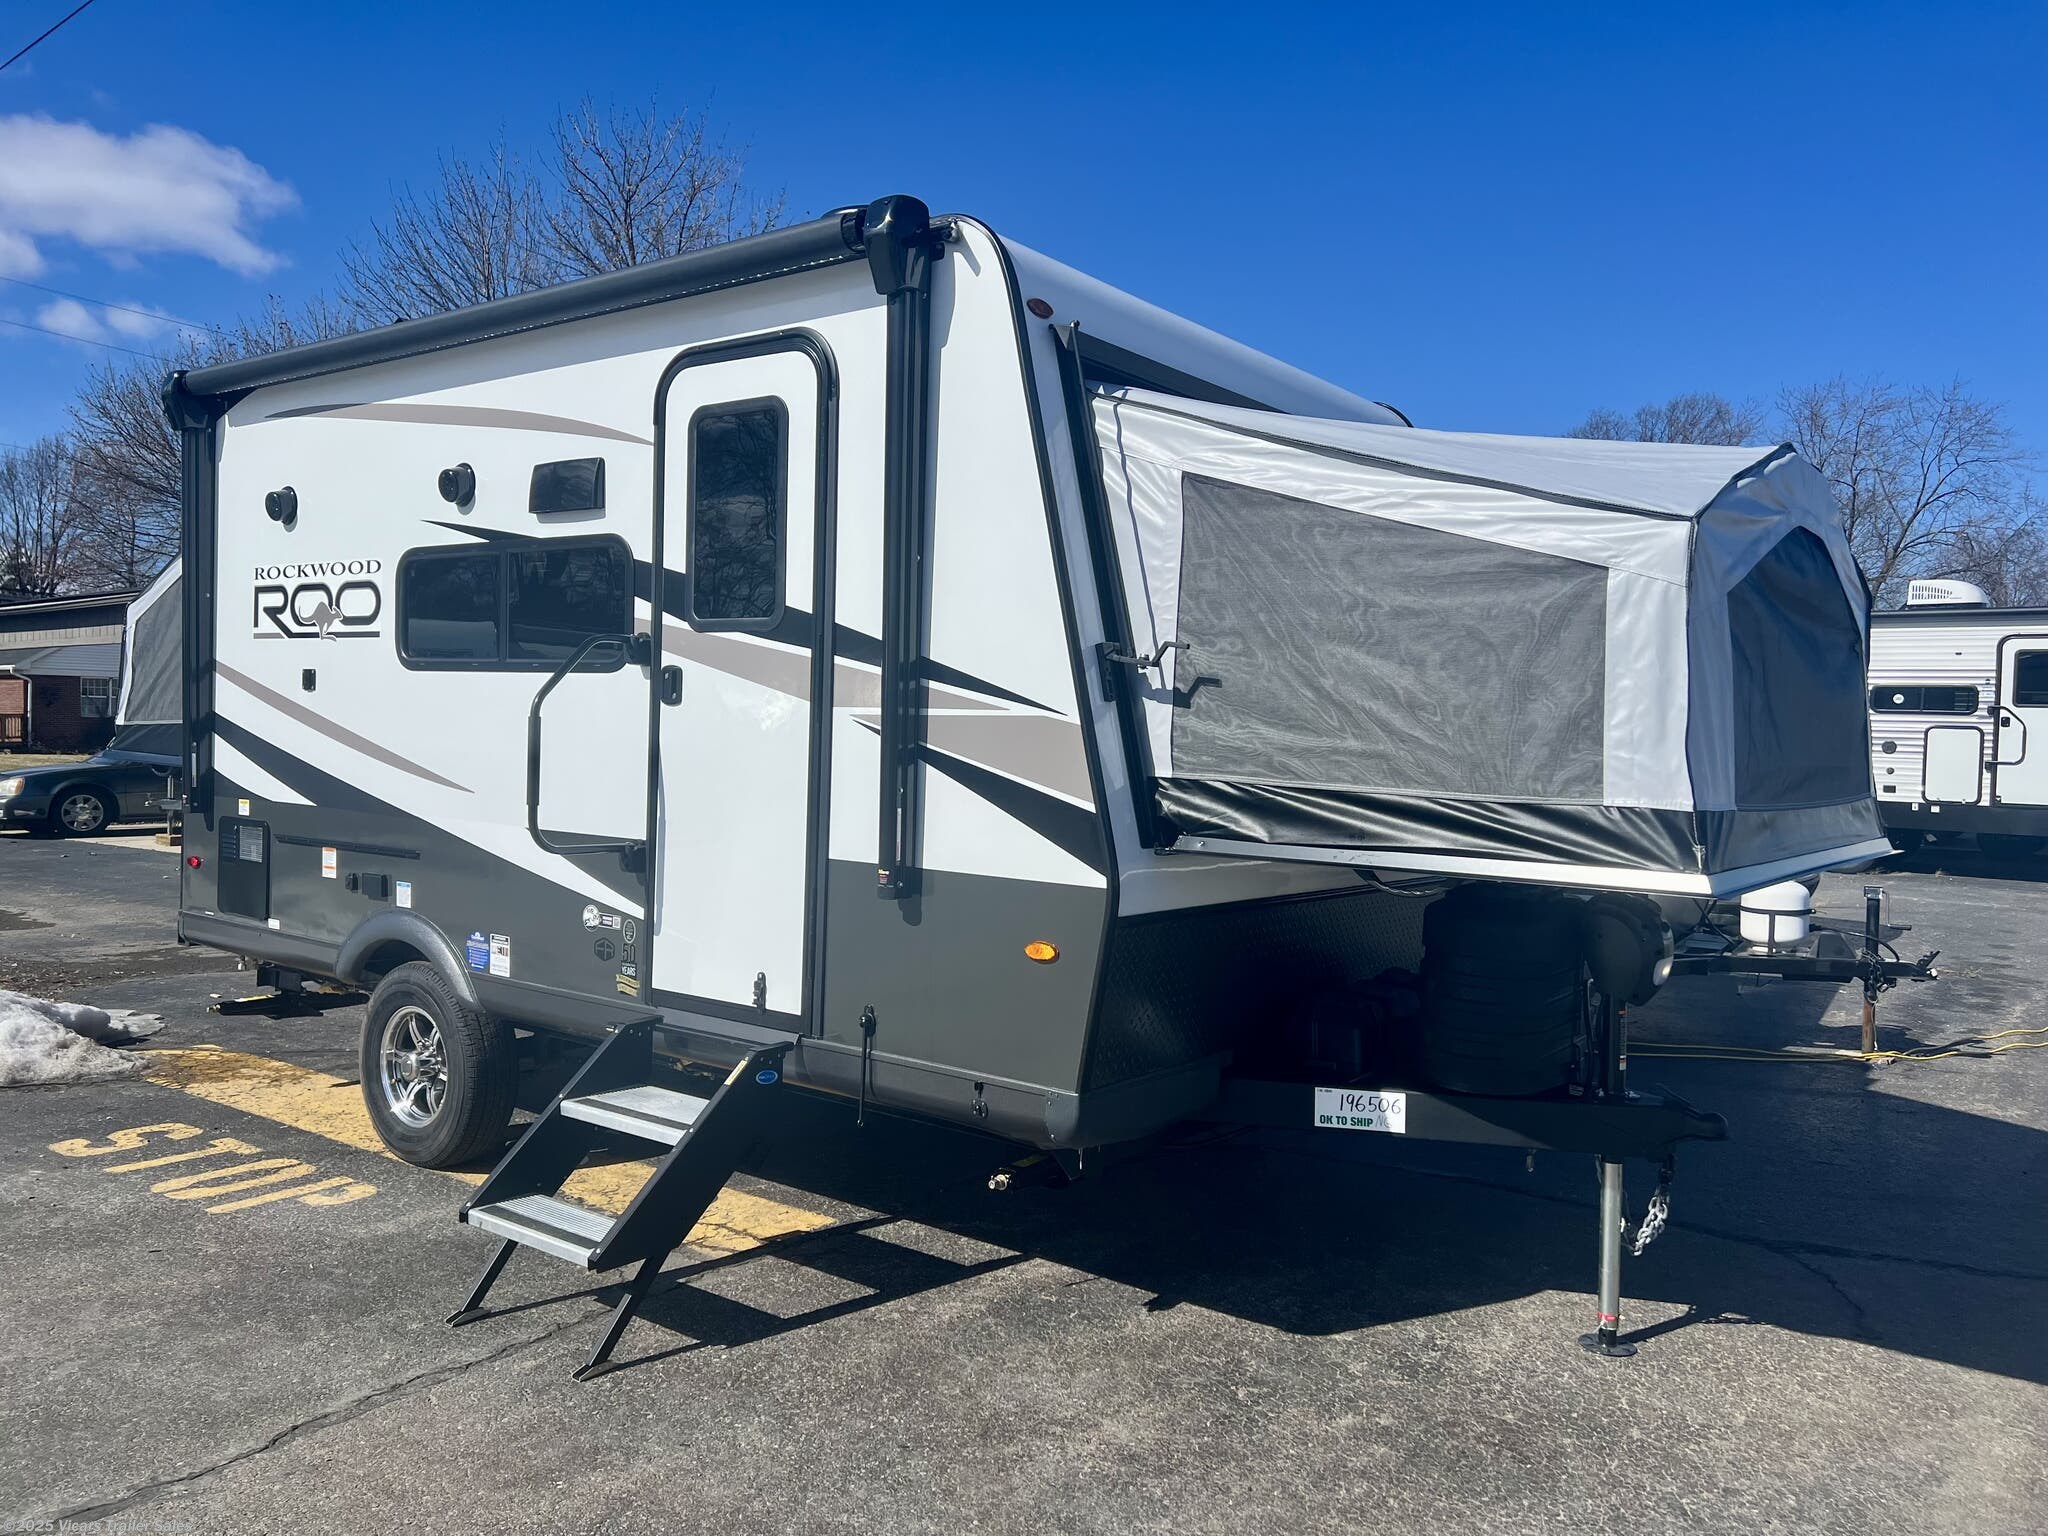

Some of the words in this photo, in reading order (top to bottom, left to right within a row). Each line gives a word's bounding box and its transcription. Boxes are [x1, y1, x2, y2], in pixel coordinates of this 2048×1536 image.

[254, 559, 381, 580] ROCKWOOD
[253, 580, 381, 639] ROO
[621, 965, 637, 976] YEARS
[1339, 1093, 1401, 1115] 196506
[1319, 1114, 1333, 1125] OK
[1335, 1115, 1348, 1126] TO
[1350, 1116, 1374, 1128] SHIP
[48, 1122, 378, 1214] STOP
